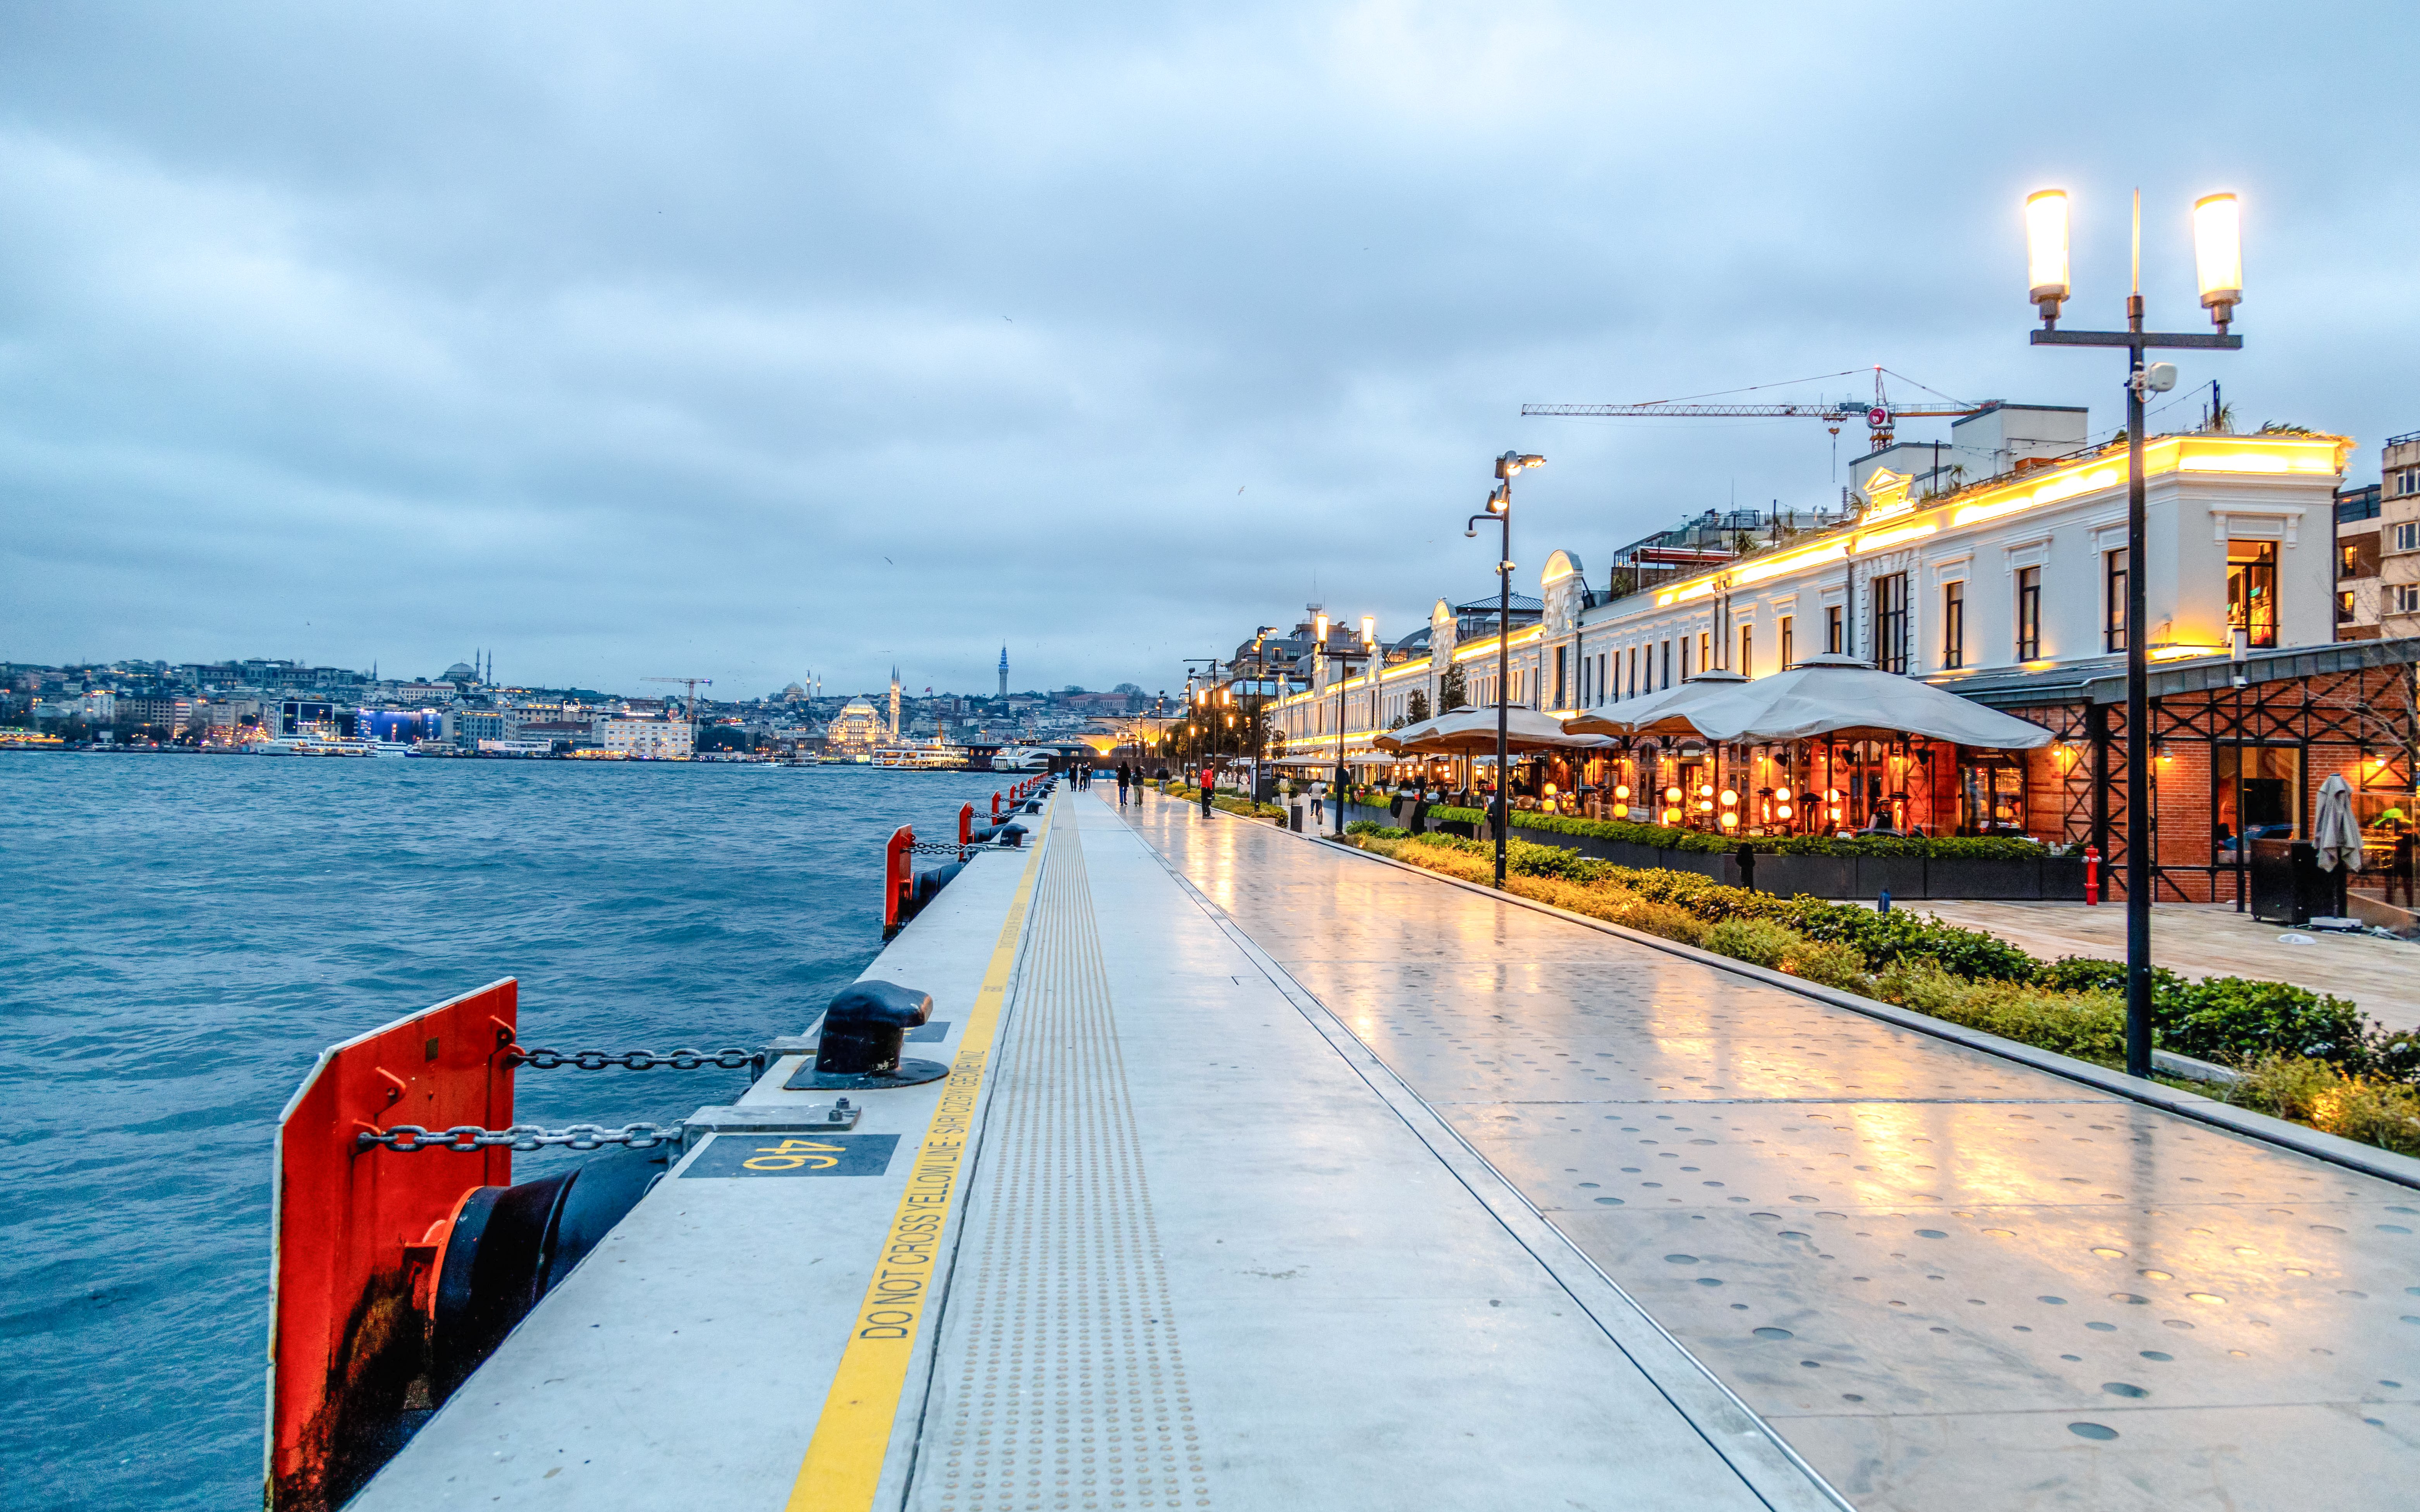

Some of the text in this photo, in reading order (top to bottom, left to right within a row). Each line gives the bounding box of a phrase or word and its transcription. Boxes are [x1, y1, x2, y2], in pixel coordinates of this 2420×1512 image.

[933, 1115, 967, 1134] SARI
[923, 1141, 961, 1162] LINE
[905, 1164, 954, 1212] YELLOW
[887, 1214, 940, 1265] CROSS
[872, 1270, 924, 1304] NOT
[859, 1311, 913, 1339] DO
